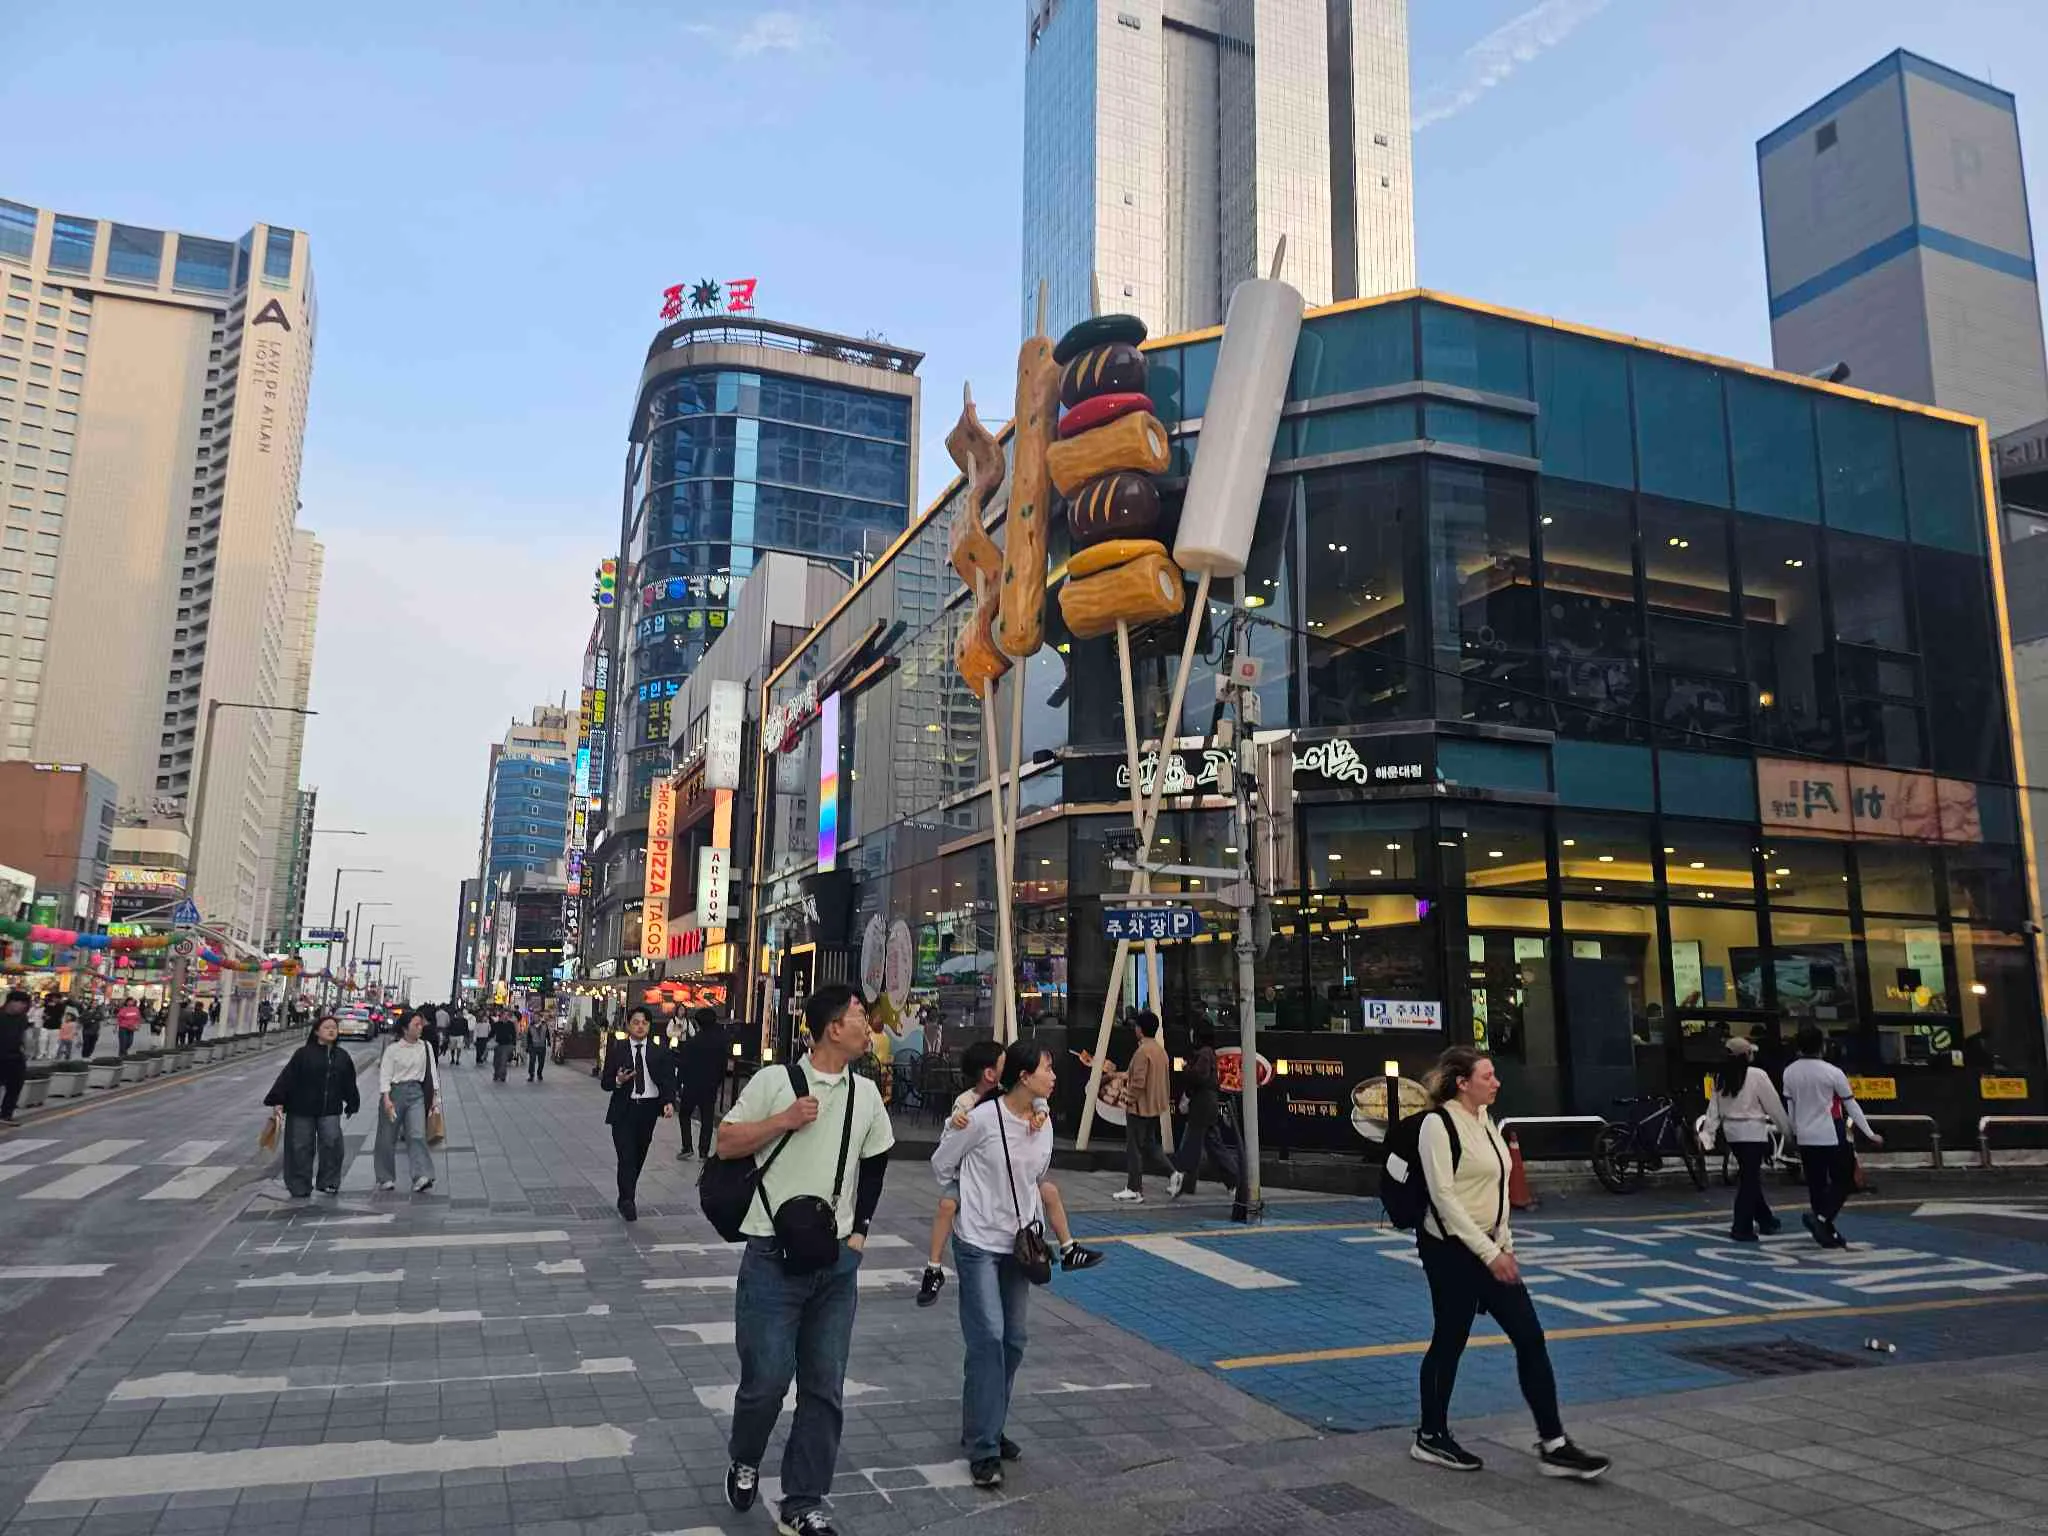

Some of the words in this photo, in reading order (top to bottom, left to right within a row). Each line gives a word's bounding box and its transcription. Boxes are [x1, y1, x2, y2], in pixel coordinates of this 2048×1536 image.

[252, 298, 291, 332] A
[252, 339, 268, 385] HOTEL
[264, 379, 278, 400] DE
[656, 783, 670, 836] CHICAGO
[650, 840, 669, 894] PIZZA
[707, 852, 721, 923] ARTBOX
[647, 902, 664, 955] TACOS
[1106, 918, 1167, 938] 주차장
[1173, 913, 1189, 933] P
[1373, 1004, 1385, 1019] P
[1396, 1003, 1435, 1017] 주차장
